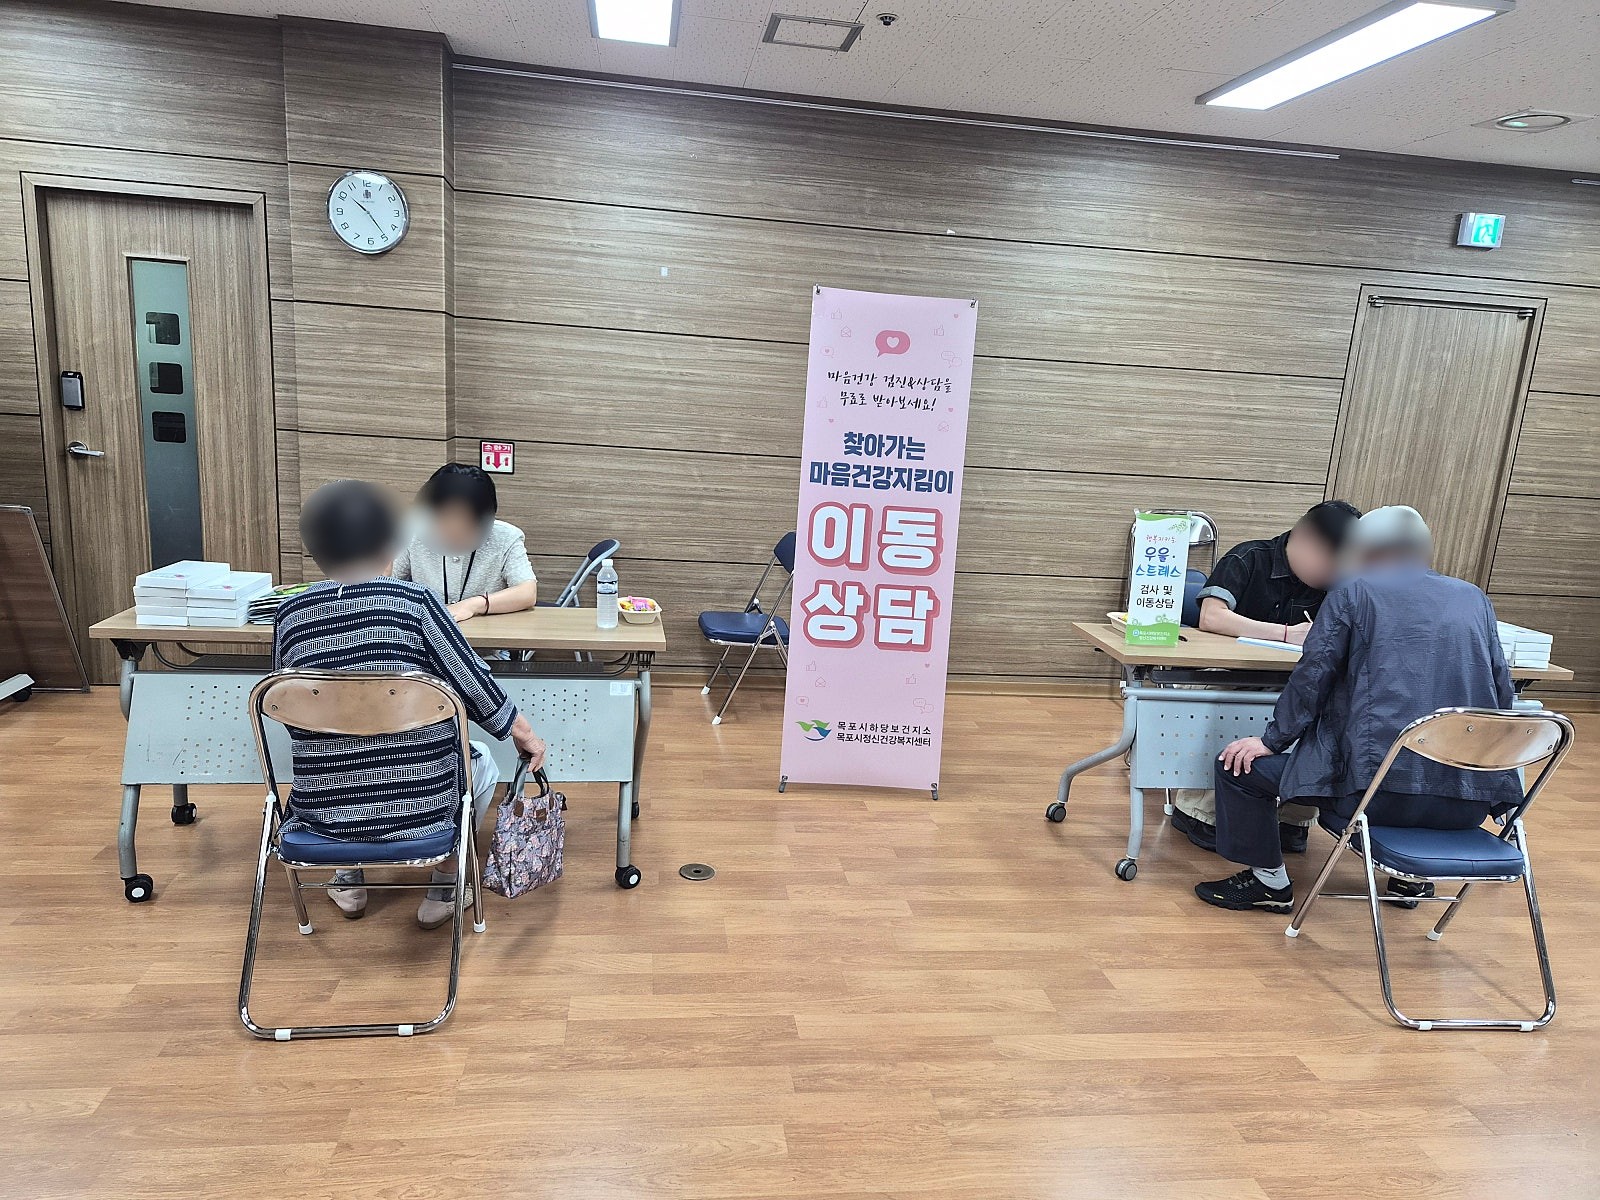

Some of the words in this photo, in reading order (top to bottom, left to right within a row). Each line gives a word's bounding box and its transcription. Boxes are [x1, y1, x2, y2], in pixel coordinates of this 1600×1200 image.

[347, 182, 357, 191] 11
[338, 190, 348, 201] 10
[387, 194, 396, 203] 2
[336, 207, 344, 216] 9
[393, 209, 400, 218] 3
[340, 221, 350, 230] 8
[390, 223, 399, 231] 4
[353, 232, 361, 240] 7
[367, 237, 375, 245] 6
[380, 233, 389, 242] 5
[827, 370, 878, 387] 마음건강
[883, 374, 952, 393] 검진&상담을
[840, 390, 867, 406] 무료로
[873, 393, 936, 412] 받아보세요!
[843, 431, 926, 461] 찾아가는
[809, 461, 954, 494] 마음건강지킴이
[808, 502, 943, 576] 이동
[1135, 564, 1182, 578] 스트레스
[1140, 584, 1159, 595] 검사
[1163, 584, 1173, 595] 및
[1136, 597, 1175, 609] 이동상담
[801, 579, 940, 652] 상담
[837, 721, 931, 735] 목포시하당보건지소
[836, 732, 931, 747] 목포시정신건강복지센터
